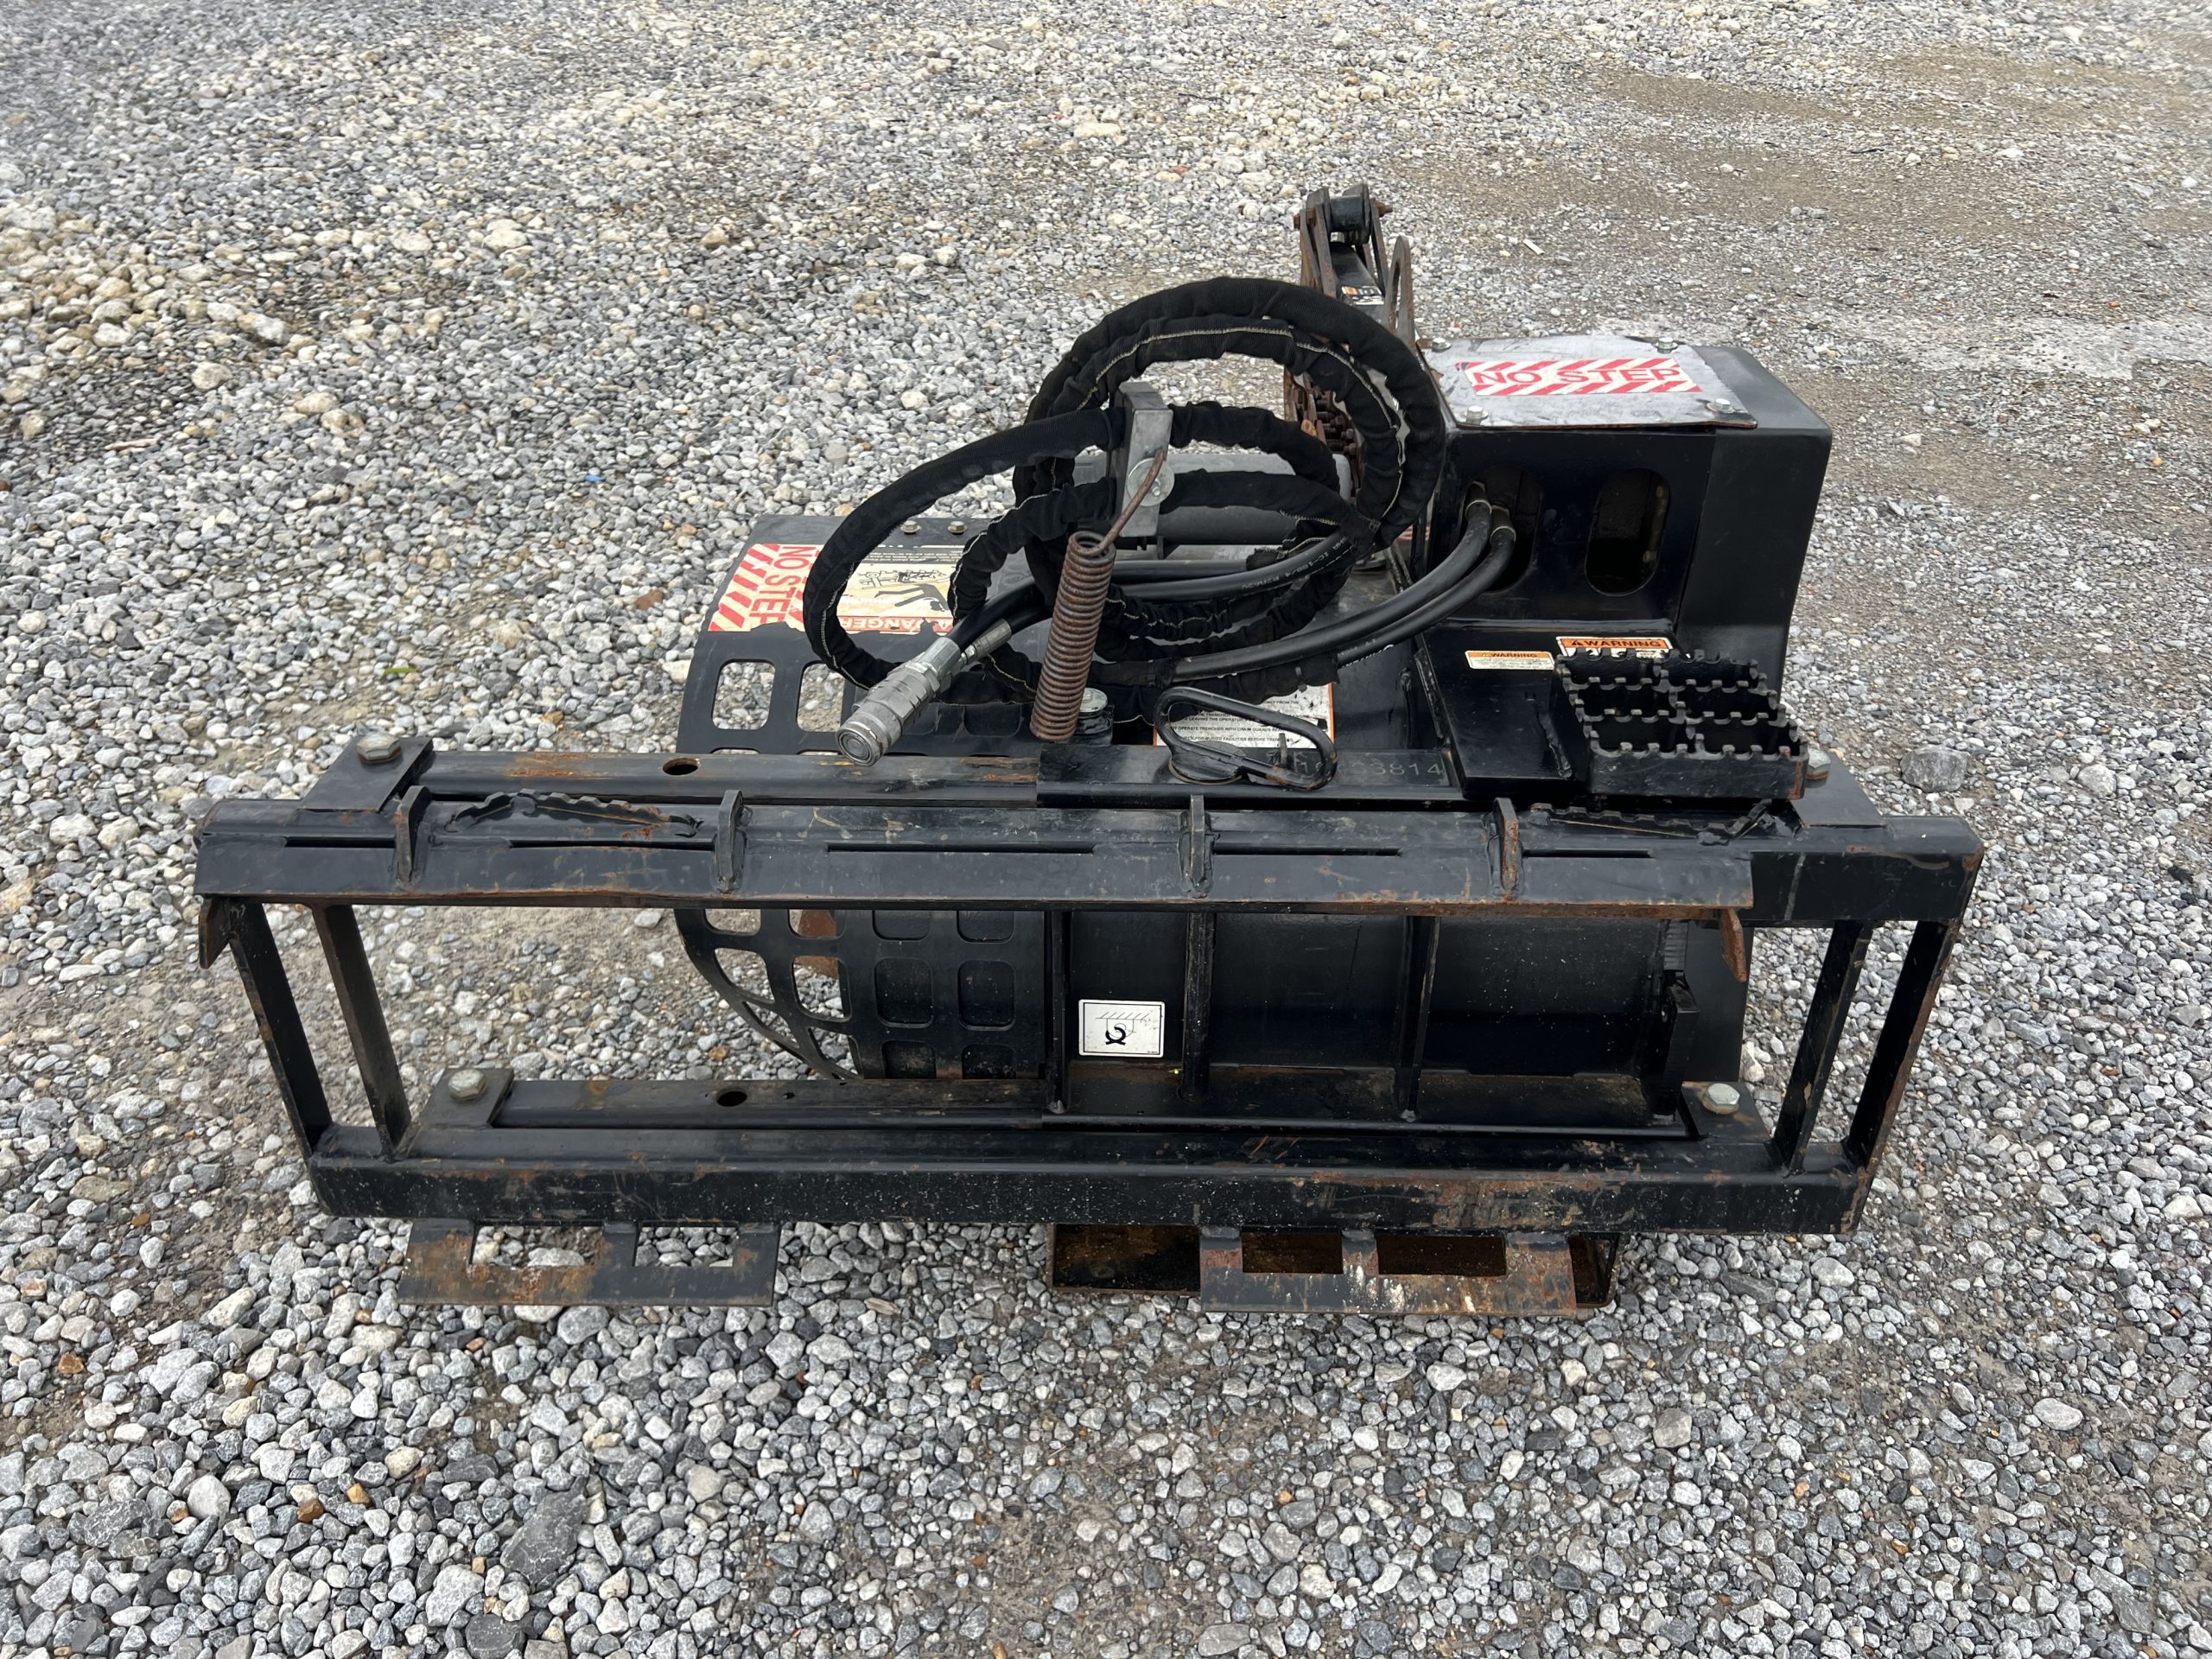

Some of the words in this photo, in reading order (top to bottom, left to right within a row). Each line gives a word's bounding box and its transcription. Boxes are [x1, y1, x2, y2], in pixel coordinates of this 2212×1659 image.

[1472, 370, 1542, 384] NO
[1556, 368, 1681, 383] STEP
[773, 546, 817, 570] NO
[1584, 639, 1662, 648] WARNING
